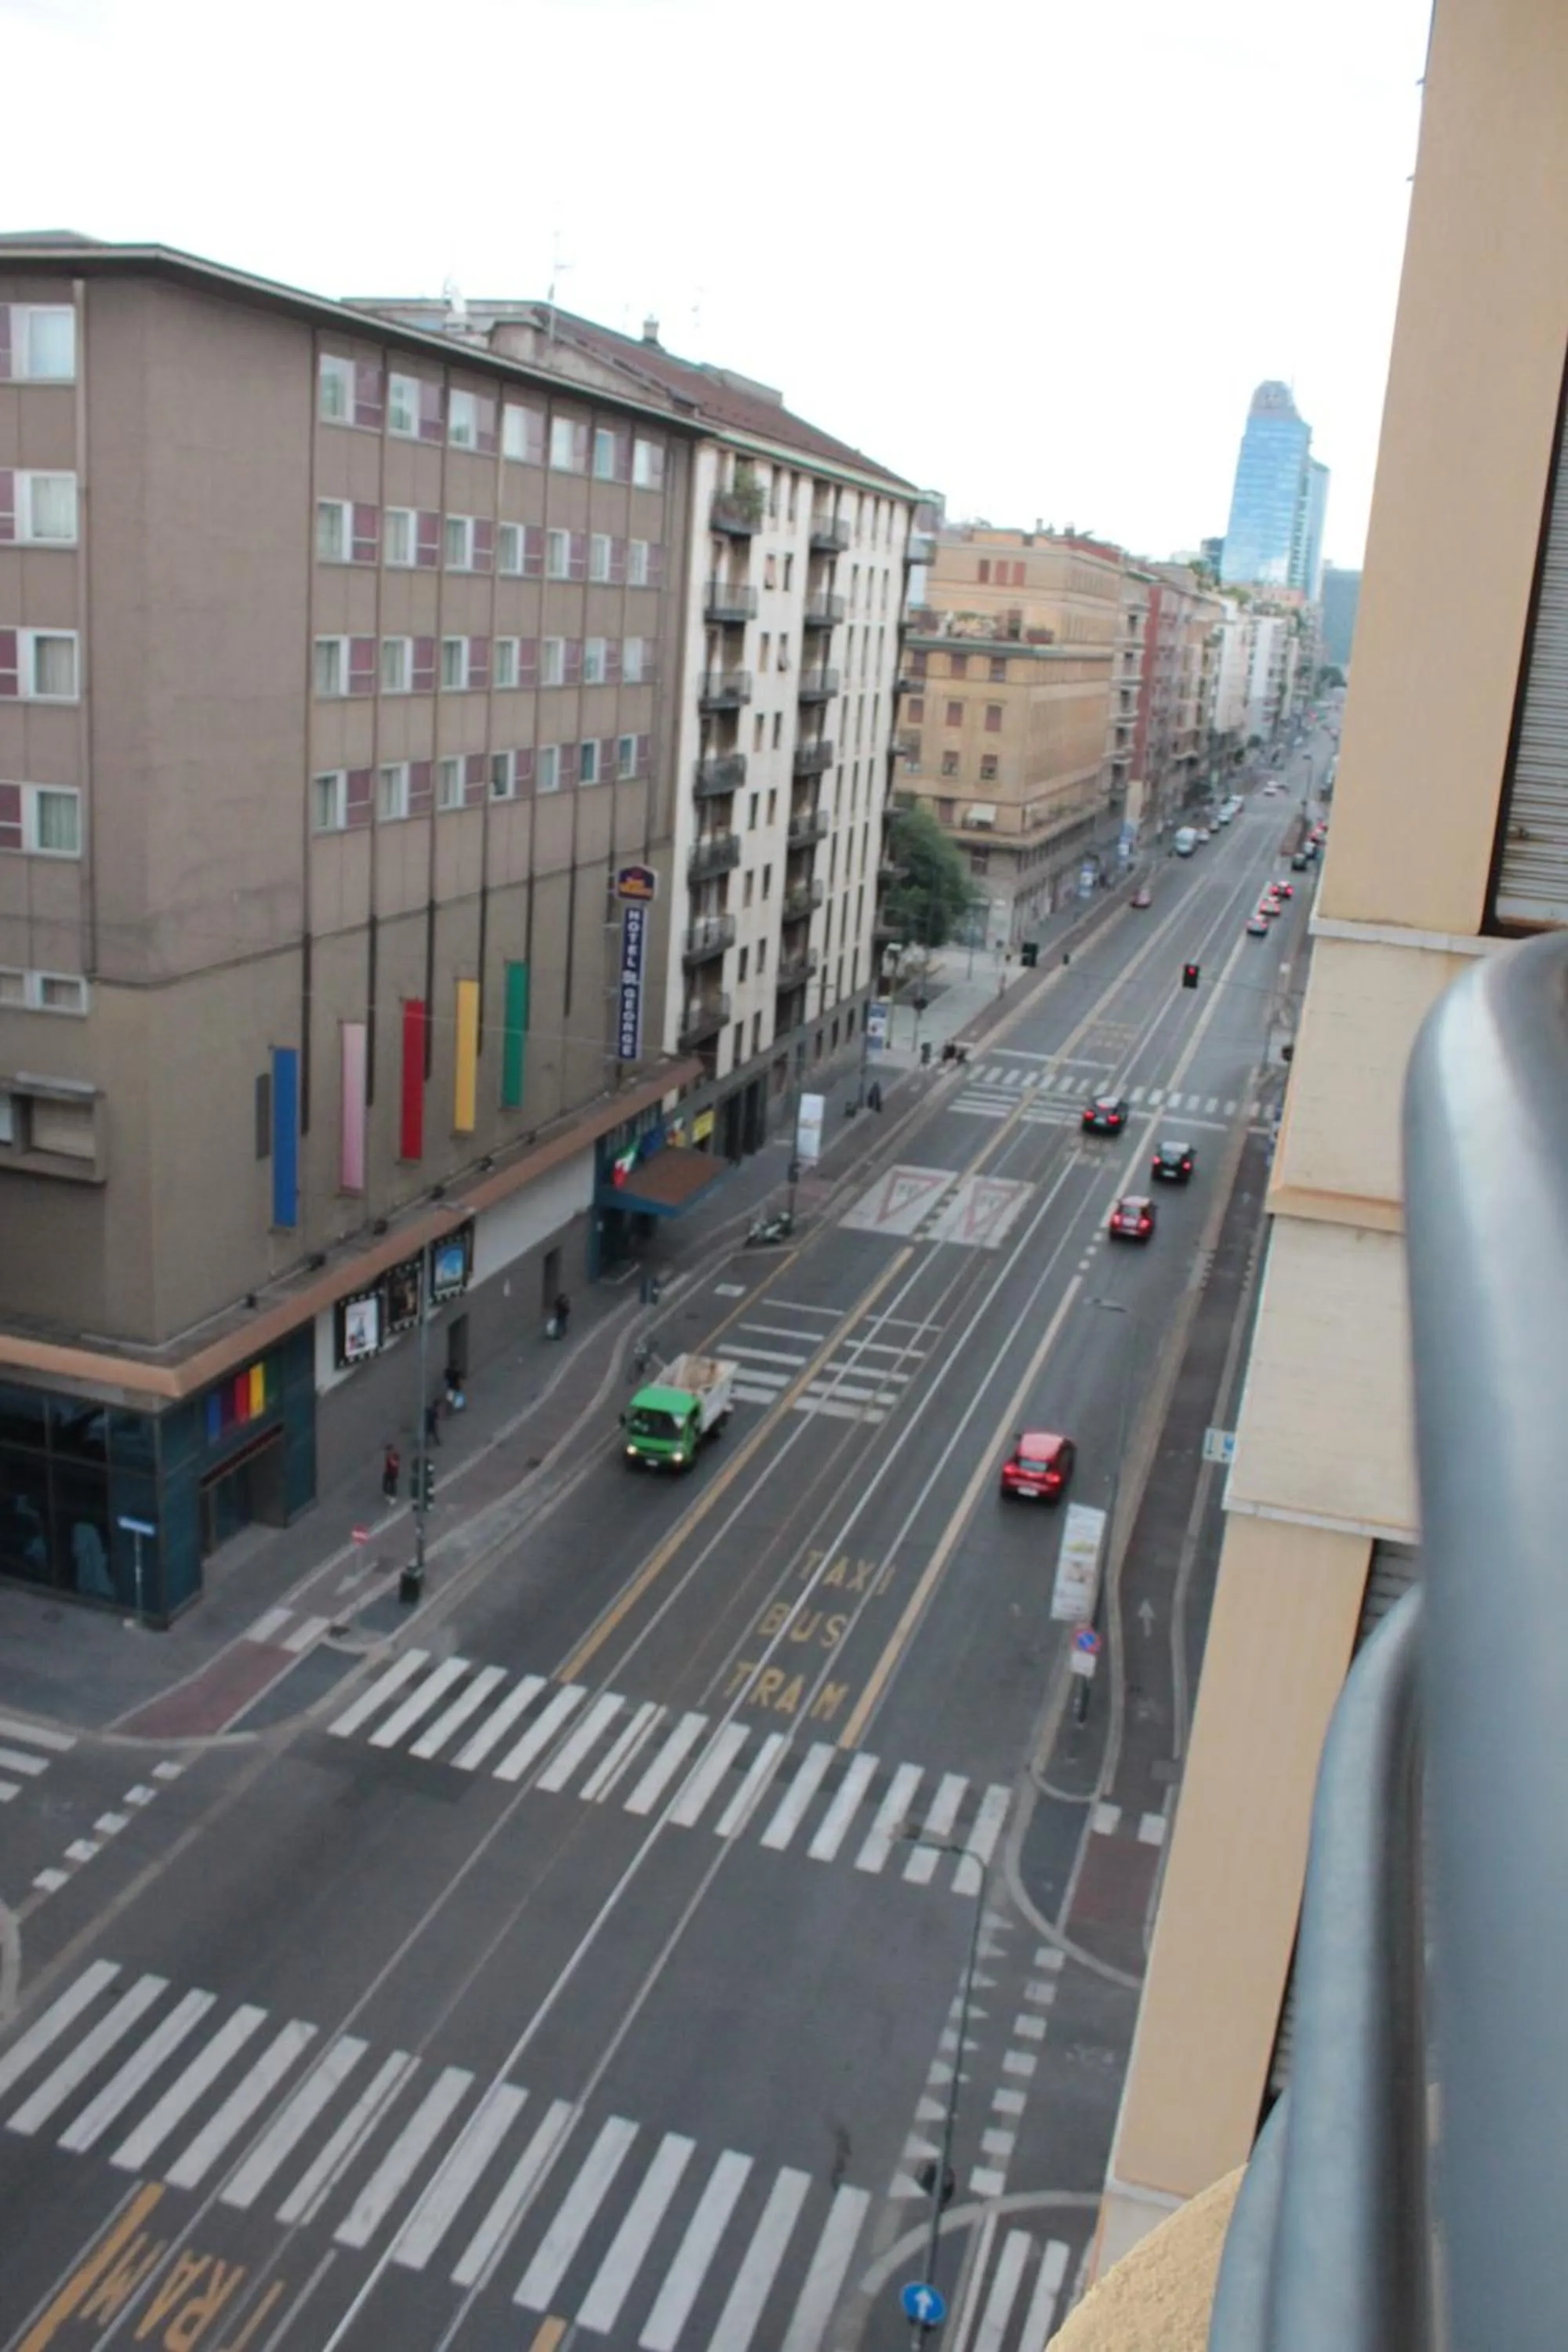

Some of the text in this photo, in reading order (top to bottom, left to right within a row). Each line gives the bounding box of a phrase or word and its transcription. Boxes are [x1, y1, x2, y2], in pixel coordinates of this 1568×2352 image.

[627, 909, 641, 968] HOTEL
[797, 1549, 896, 1595] TAXI
[757, 1602, 849, 1648] BUS
[722, 1660, 850, 1721] TRAM
